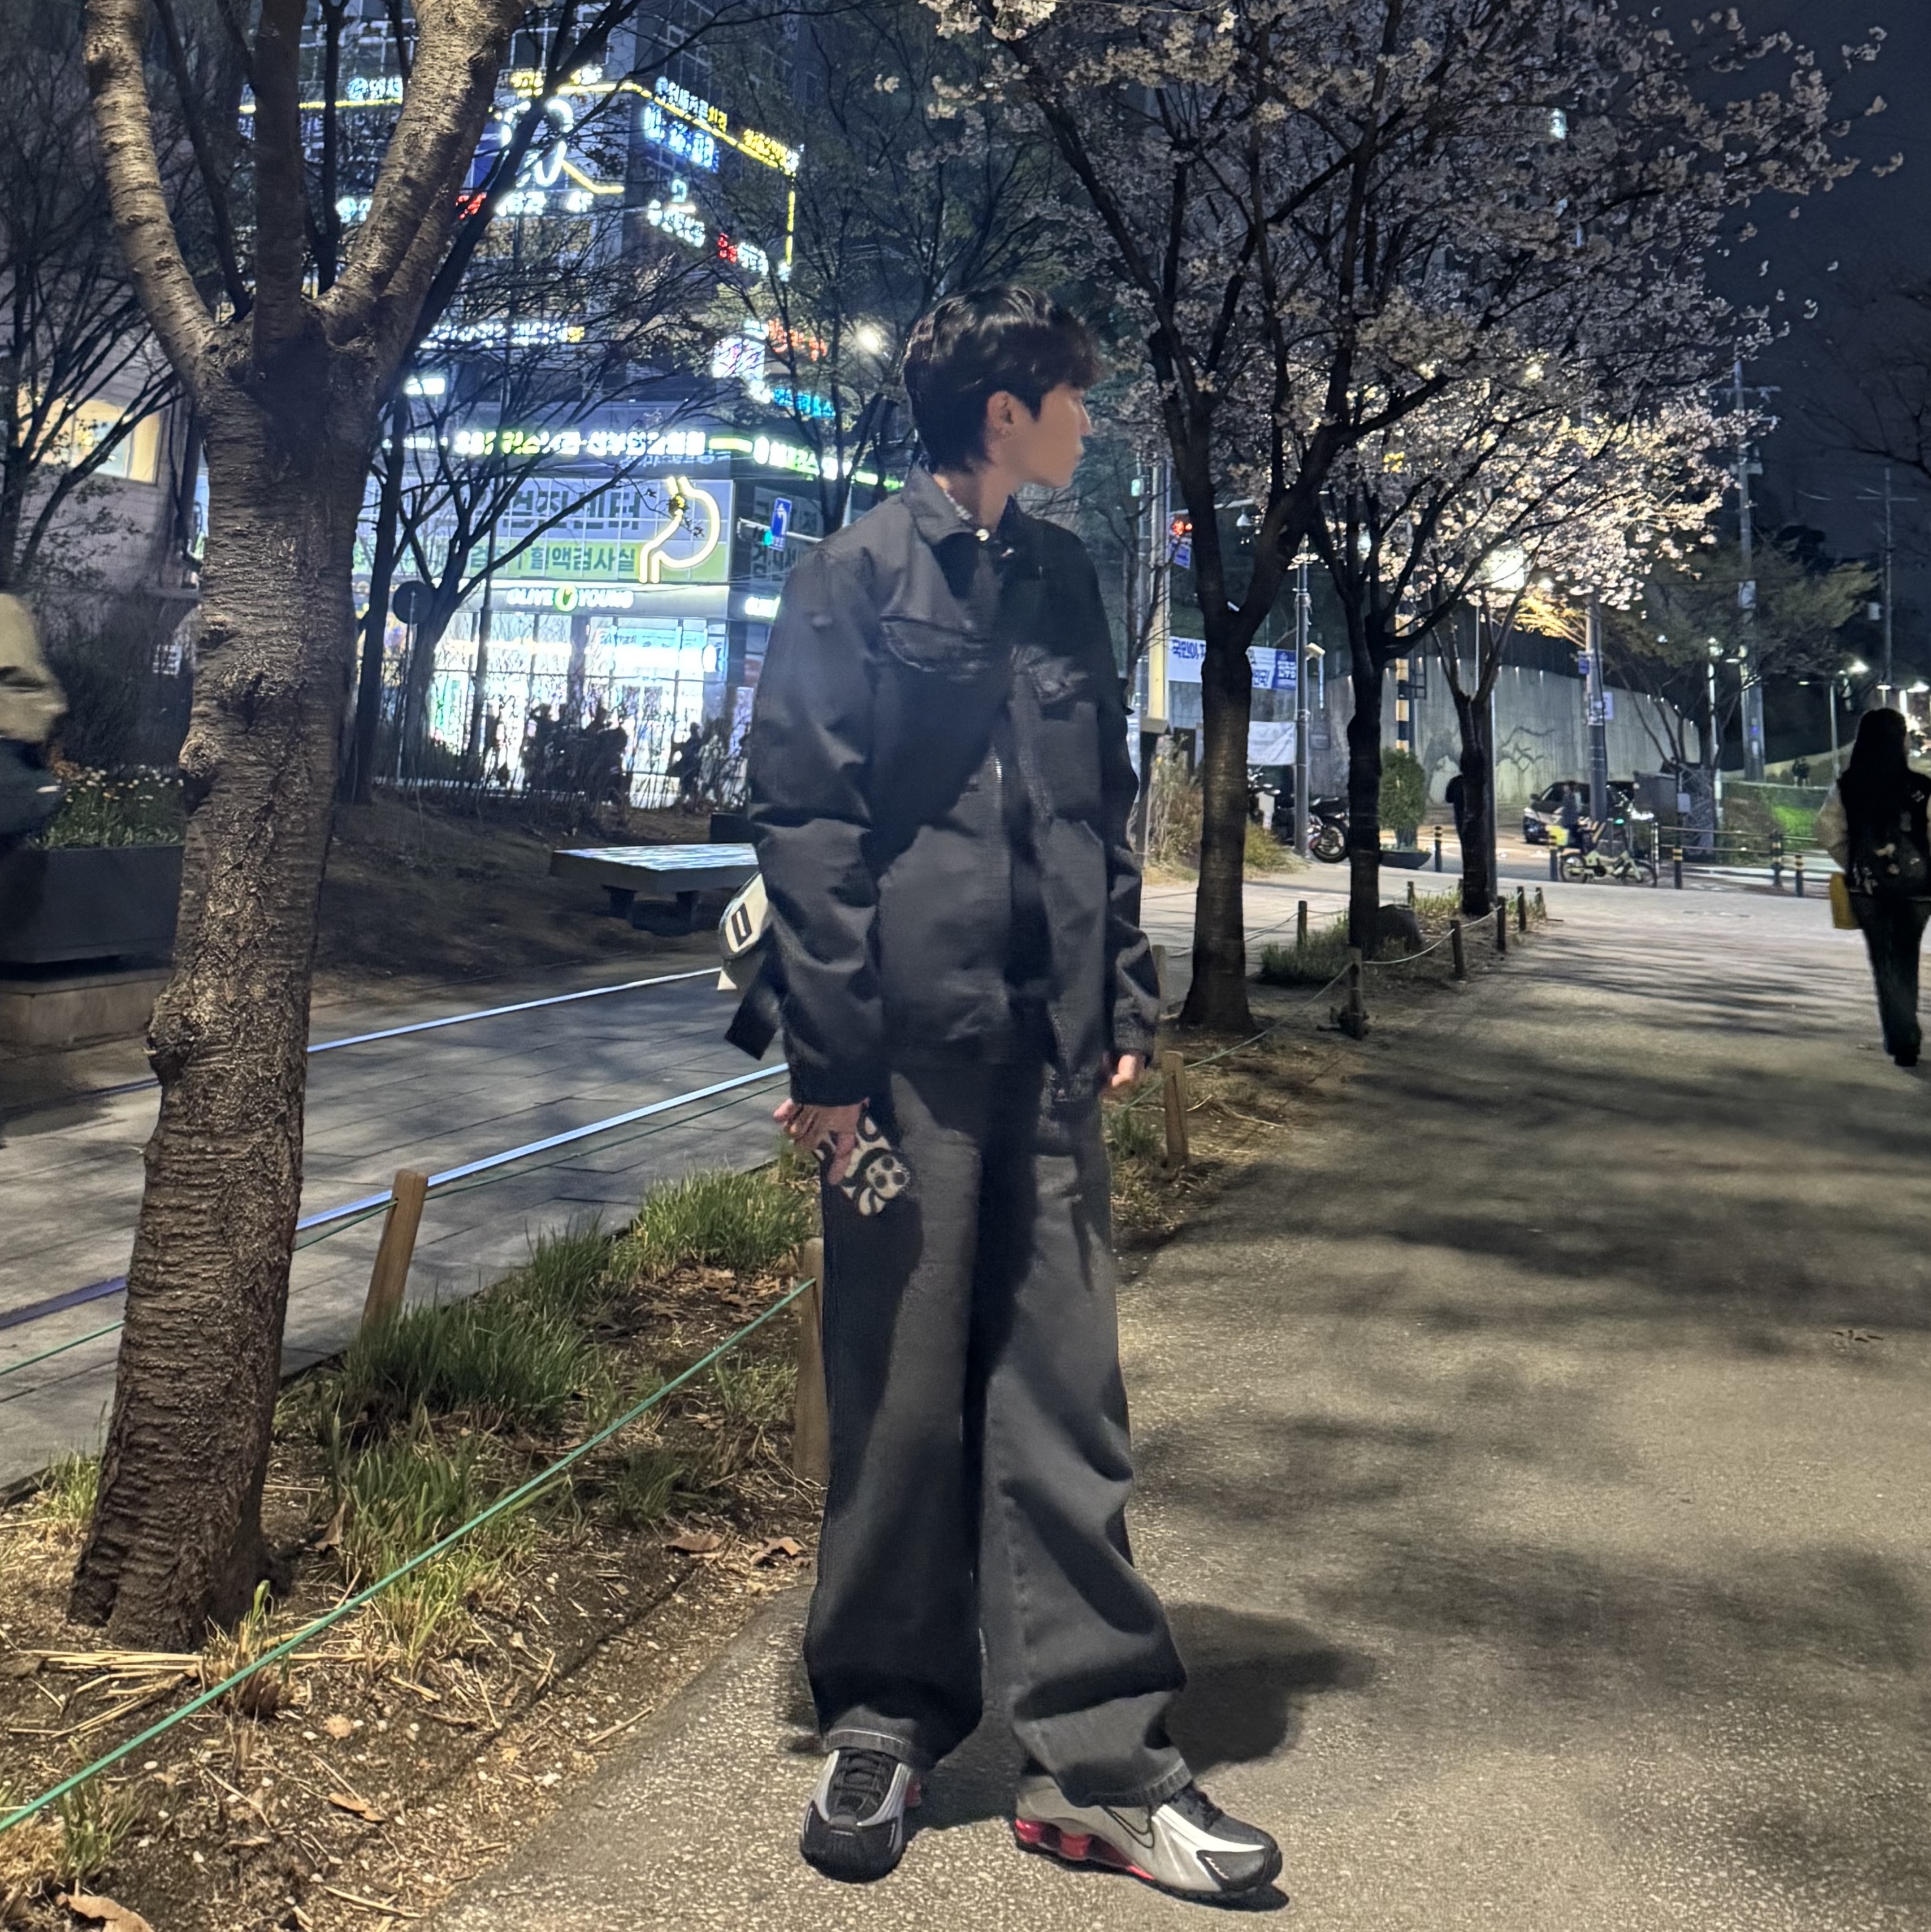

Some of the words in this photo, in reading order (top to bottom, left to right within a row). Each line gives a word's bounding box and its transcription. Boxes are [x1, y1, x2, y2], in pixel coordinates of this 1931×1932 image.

[530, 546, 636, 572] 혈액검사실
[506, 588, 555, 607] OLIVE
[578, 588, 634, 609] YOUNG
